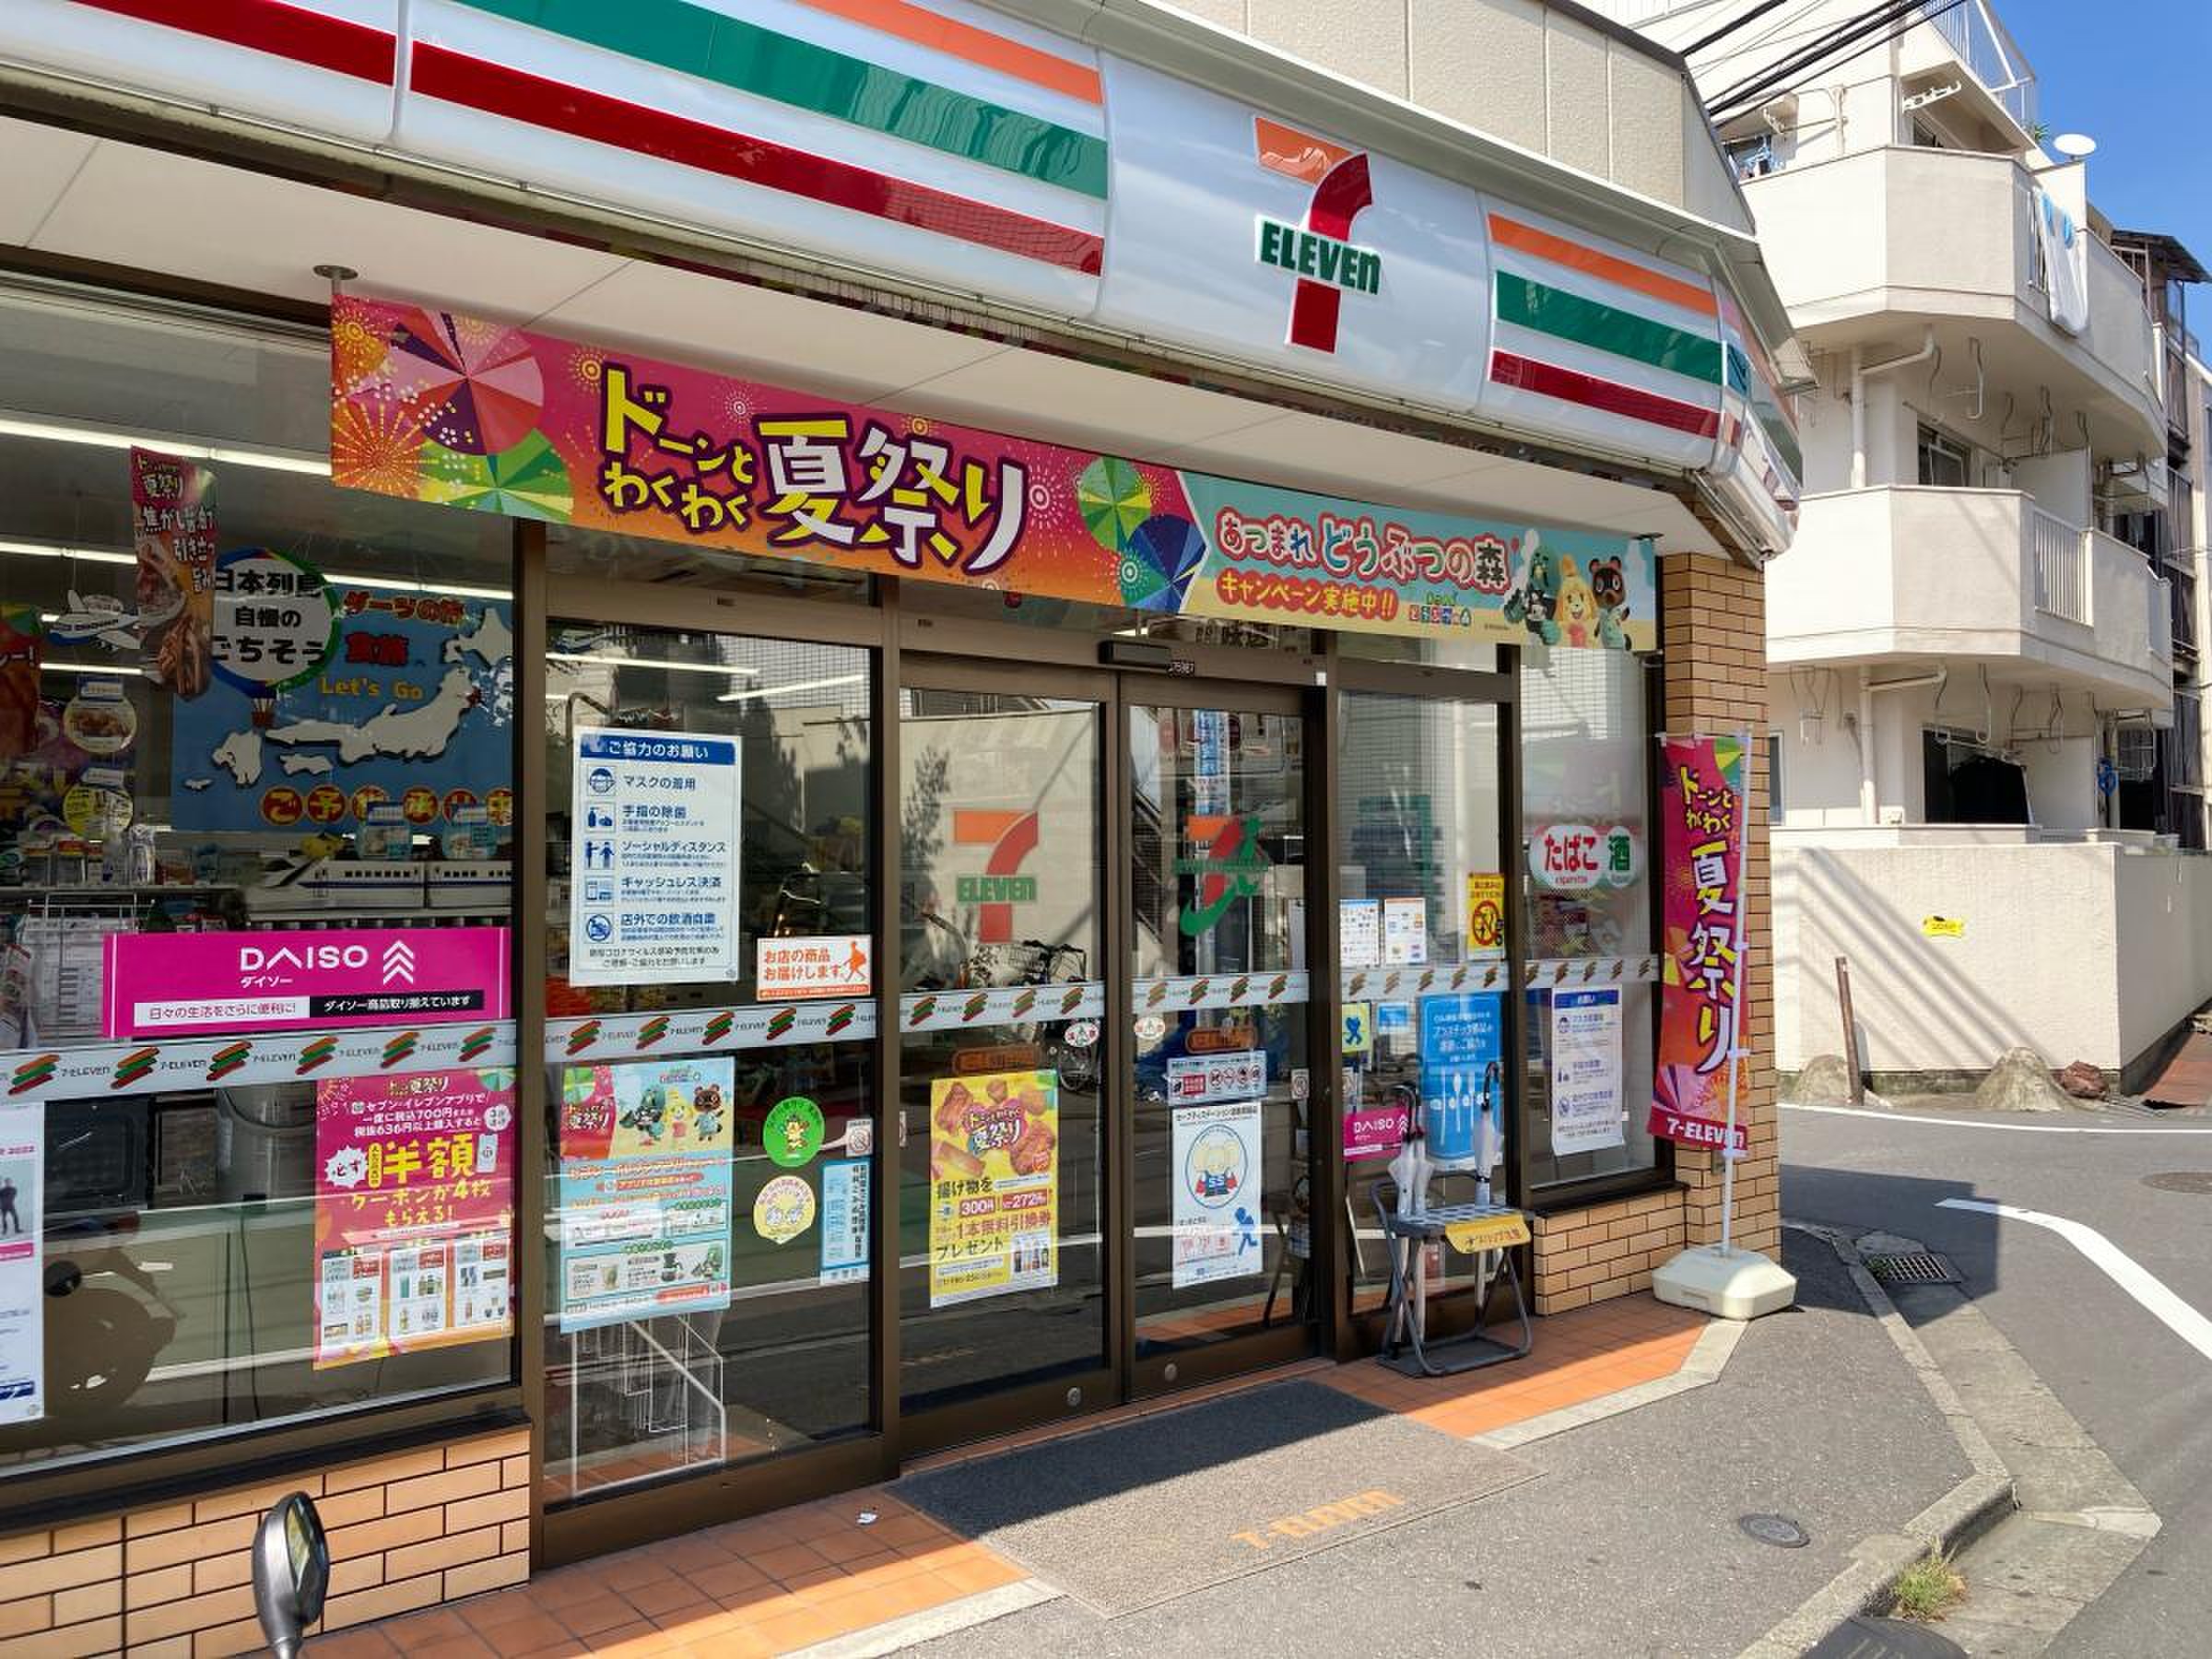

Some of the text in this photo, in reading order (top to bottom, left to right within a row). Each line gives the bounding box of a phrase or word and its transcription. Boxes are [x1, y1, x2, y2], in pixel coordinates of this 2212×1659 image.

[606, 367, 754, 485] ドーンと
[603, 461, 749, 529] わくわく
[758, 417, 1025, 571] 夏祭り
[214, 567, 323, 598] 日本列島
[234, 605, 302, 629] 自慢の
[321, 677, 423, 700] Let's Go
[608, 741, 709, 759] ご協力のお願い
[1544, 833, 1631, 872] たばこ 酒
[241, 945, 369, 972] DAISO
[240, 975, 294, 989] ダイソー
[382, 1134, 474, 1184] 半額
